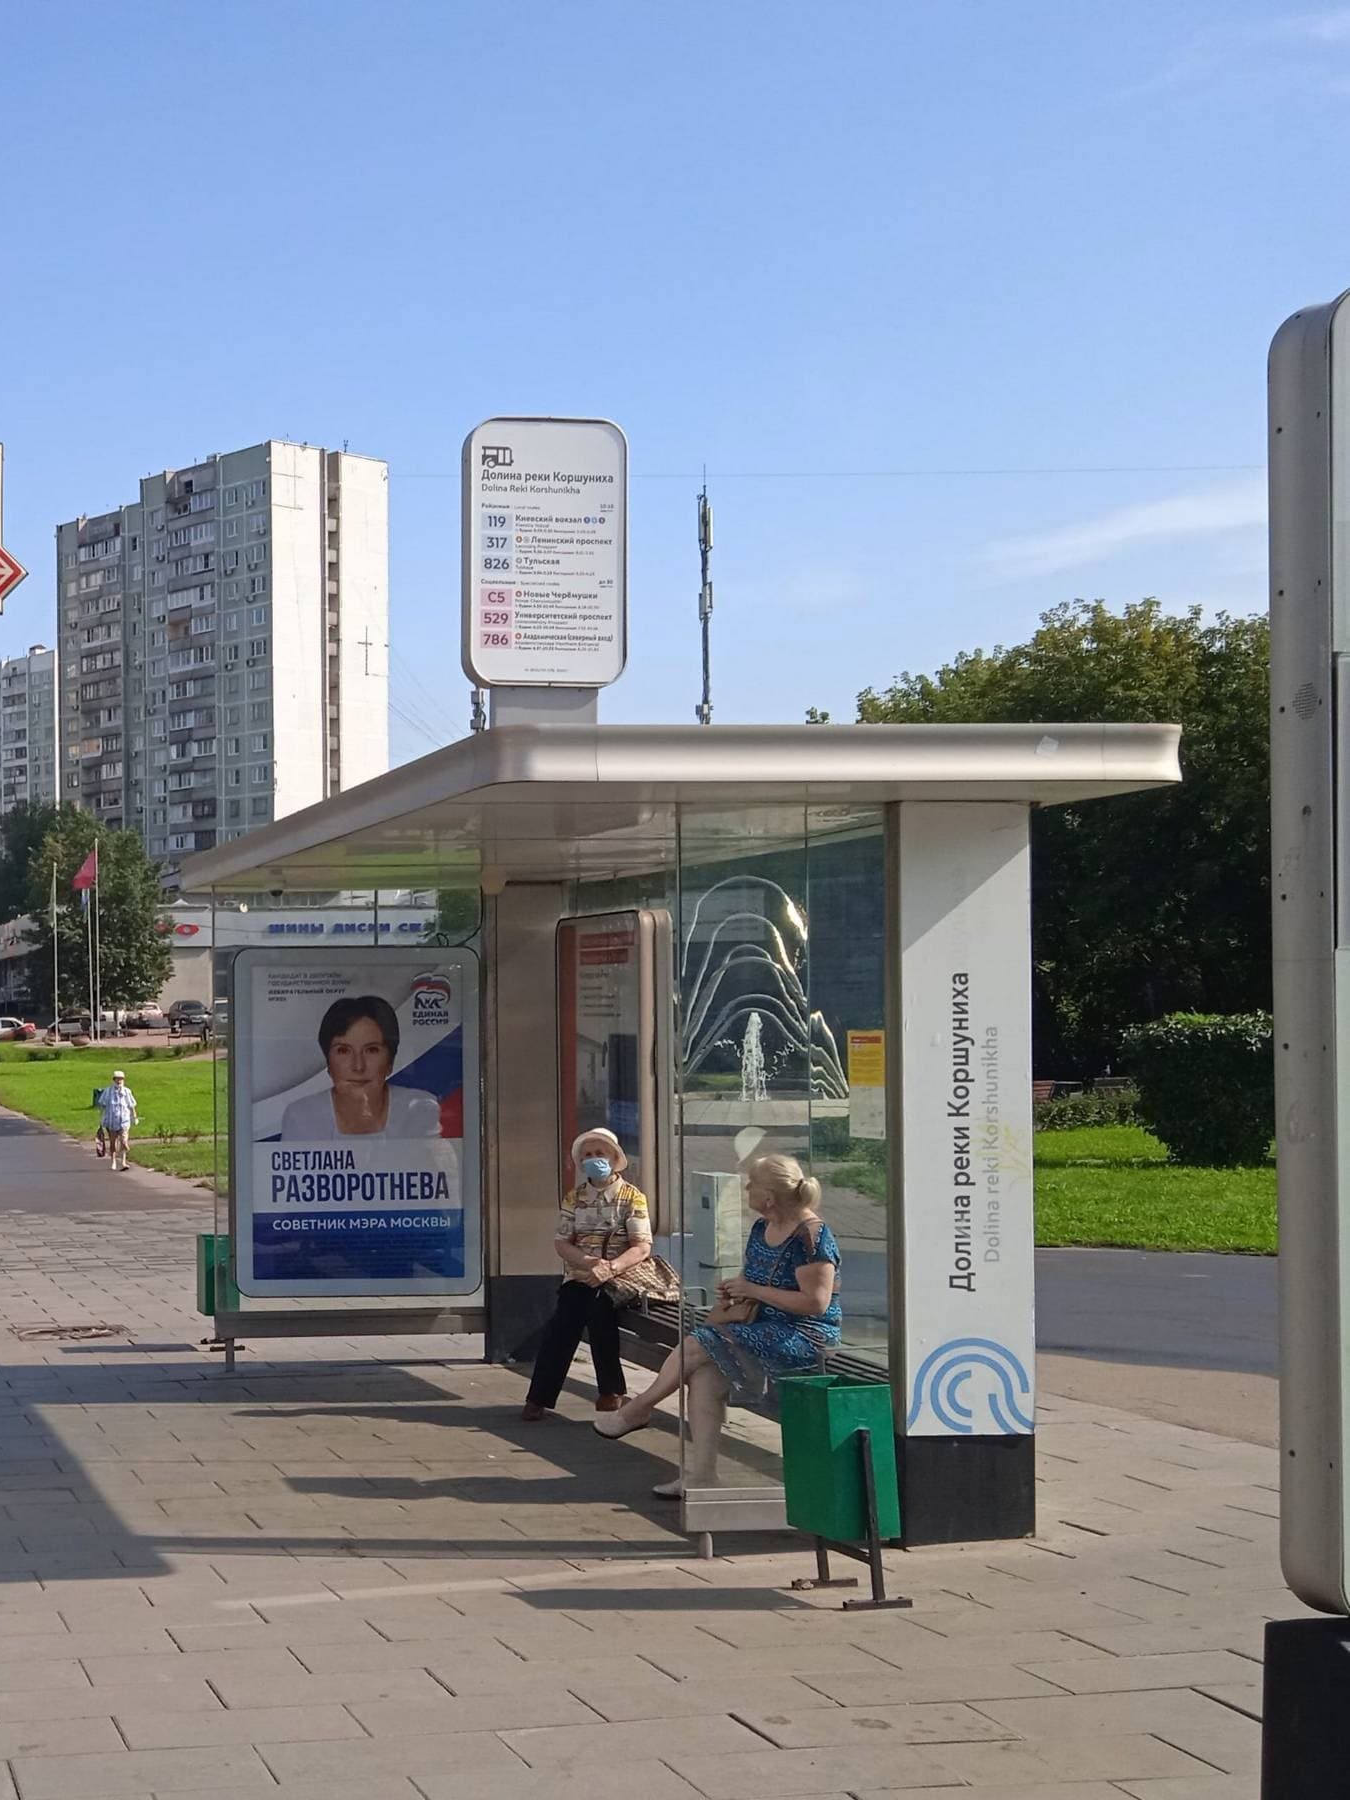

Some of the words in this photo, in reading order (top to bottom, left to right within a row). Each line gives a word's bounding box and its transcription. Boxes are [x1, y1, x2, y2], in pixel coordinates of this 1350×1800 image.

[481, 470, 522, 481] Долина
[525, 472, 550, 483] реки
[553, 472, 614, 484] Коршуниха
[481, 484, 508, 492] Dolina
[510, 485, 528, 493] Reki
[487, 516, 506, 528] 119
[515, 514, 554, 524] Киевский
[555, 516, 583, 524] вокзал
[486, 537, 507, 549] 317
[531, 536, 574, 545] Ленинский
[576, 538, 612, 546] проспект
[484, 558, 510, 570] 826
[523, 557, 560, 567] Тульская
[523, 591, 550, 599] Новые
[551, 591, 598, 601] Черёмушки
[484, 613, 509, 625] 529
[515, 611, 577, 621] Университетский
[579, 613, 613, 622] проспект
[483, 633, 509, 645] 786
[268, 922, 324, 934] ШИНЫ
[412, 1018, 449, 1026] РОССИЯ
[947, 972, 975, 1117] Коршуниха
[981, 1026, 1000, 1149] Korshunikha
[272, 1150, 355, 1171] СВЕТЛАНА
[953, 1126, 976, 1186] реки
[983, 1156, 999, 1193] reki
[272, 1171, 449, 1202] РАЗВОРОТНЕВА
[273, 1218, 347, 1231] СОВЕТНИК
[350, 1217, 387, 1229] МЭРА
[390, 1215, 451, 1228] МОСКВЫ
[983, 1200, 1000, 1262] Dolina
[949, 1195, 976, 1292] Долина
